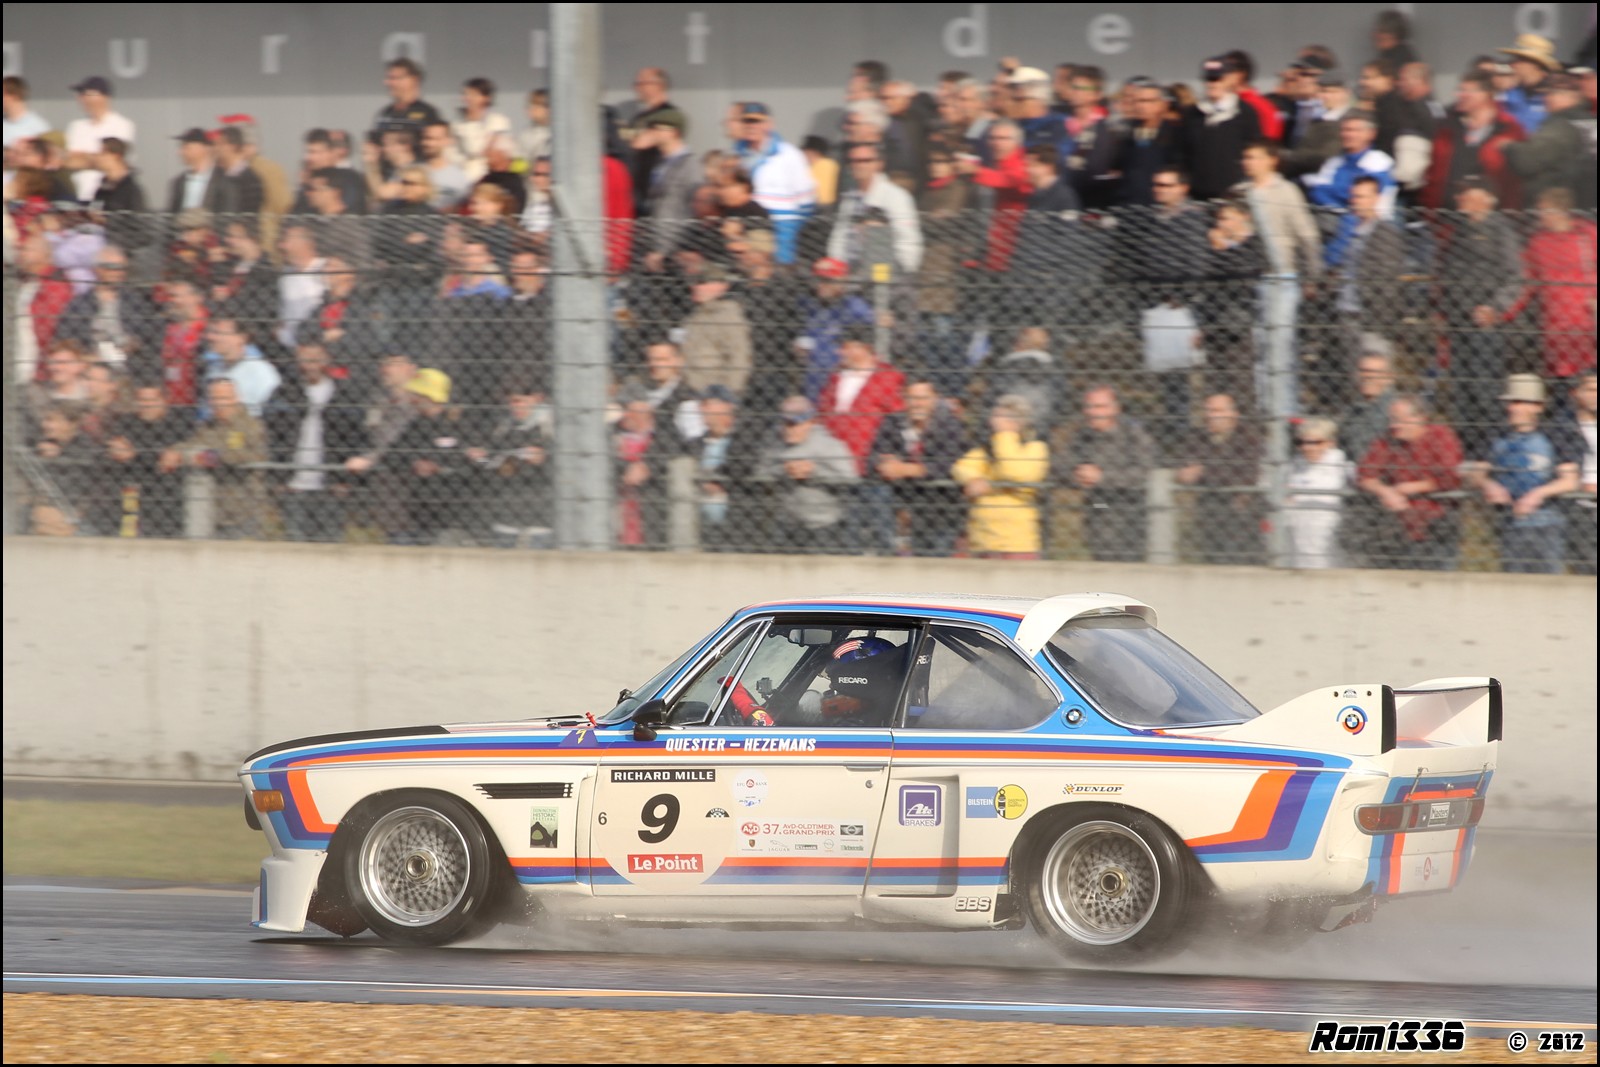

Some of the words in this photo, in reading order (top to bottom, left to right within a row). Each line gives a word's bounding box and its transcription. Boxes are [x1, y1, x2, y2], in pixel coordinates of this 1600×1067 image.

[838, 677, 868, 685] RECARO
[665, 738, 726, 752] QUESTER
[743, 738, 816, 752] HEZEMANS
[614, 771, 671, 781] RICHARD
[675, 771, 714, 781] MILLE
[1074, 785, 1122, 793] DUNLOP
[967, 798, 994, 806] BILSTEIN
[598, 812, 608, 825] 6
[637, 793, 681, 844] 9
[905, 819, 935, 827] BRAKES
[763, 823, 782, 835] 37.
[633, 856, 652, 871] Le
[655, 855, 698, 871] Point
[955, 896, 991, 912] BBS
